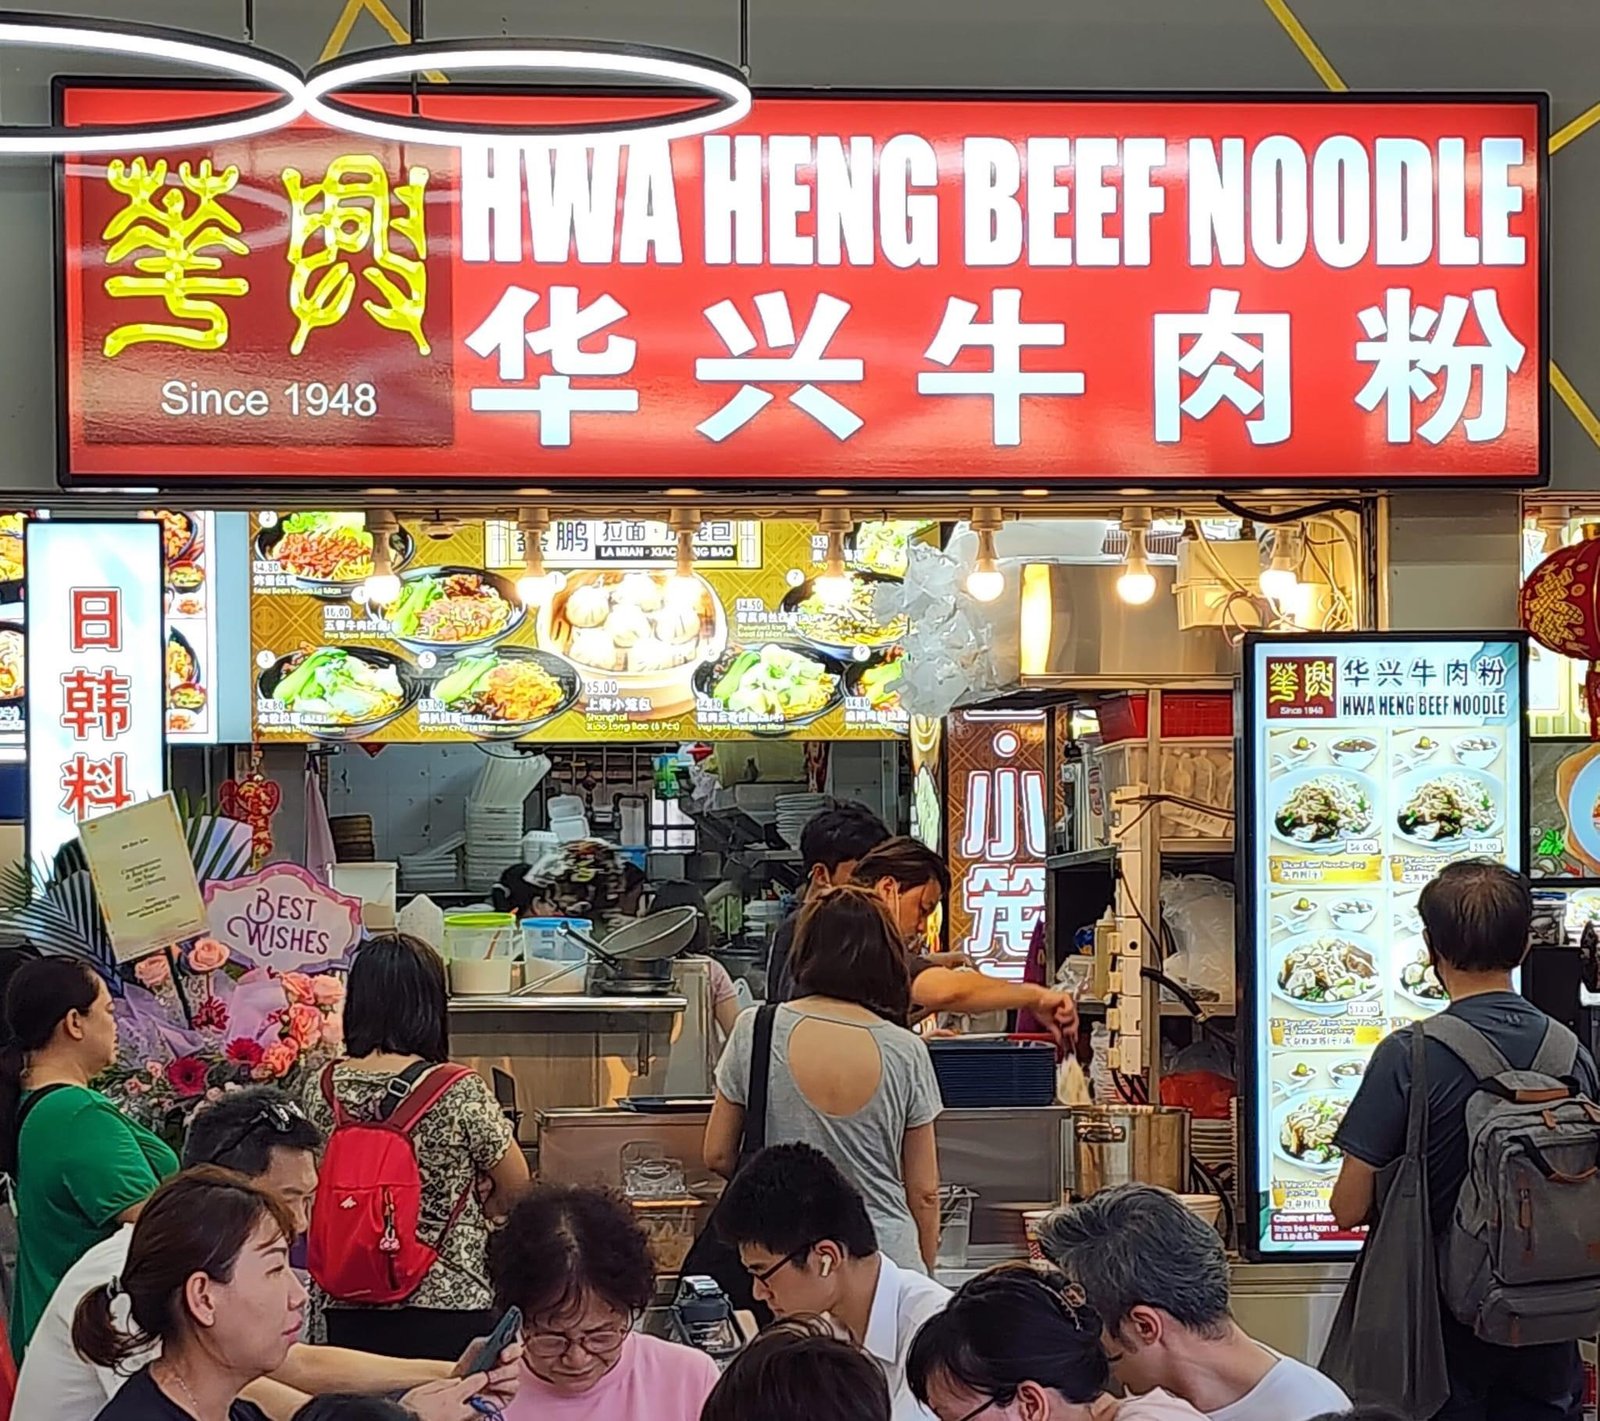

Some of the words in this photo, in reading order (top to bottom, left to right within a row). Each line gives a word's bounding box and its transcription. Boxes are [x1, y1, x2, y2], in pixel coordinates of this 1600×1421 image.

[461, 139, 682, 264] HWA
[704, 134, 938, 268] HENG
[963, 134, 1166, 267] BEEF
[1188, 134, 1527, 268] NOODLE
[464, 285, 1527, 447] 华兴牛肉粉
[161, 382, 269, 418] Since
[284, 382, 377, 418] 1948
[600, 547, 614, 557] LA
[615, 547, 644, 557] MIAN
[1344, 659, 1505, 687] 华兴牛肉粉
[586, 681, 618, 694] $5.00
[586, 713, 628, 722] Shanghai
[1343, 696, 1374, 716] HWA
[1379, 696, 1414, 715] HENG
[1419, 695, 1450, 715] BEEF
[1453, 694, 1506, 715] NOODLE
[631, 722, 650, 731] Bao
[246, 888, 318, 924] BEST
[227, 916, 330, 957] WISHES
